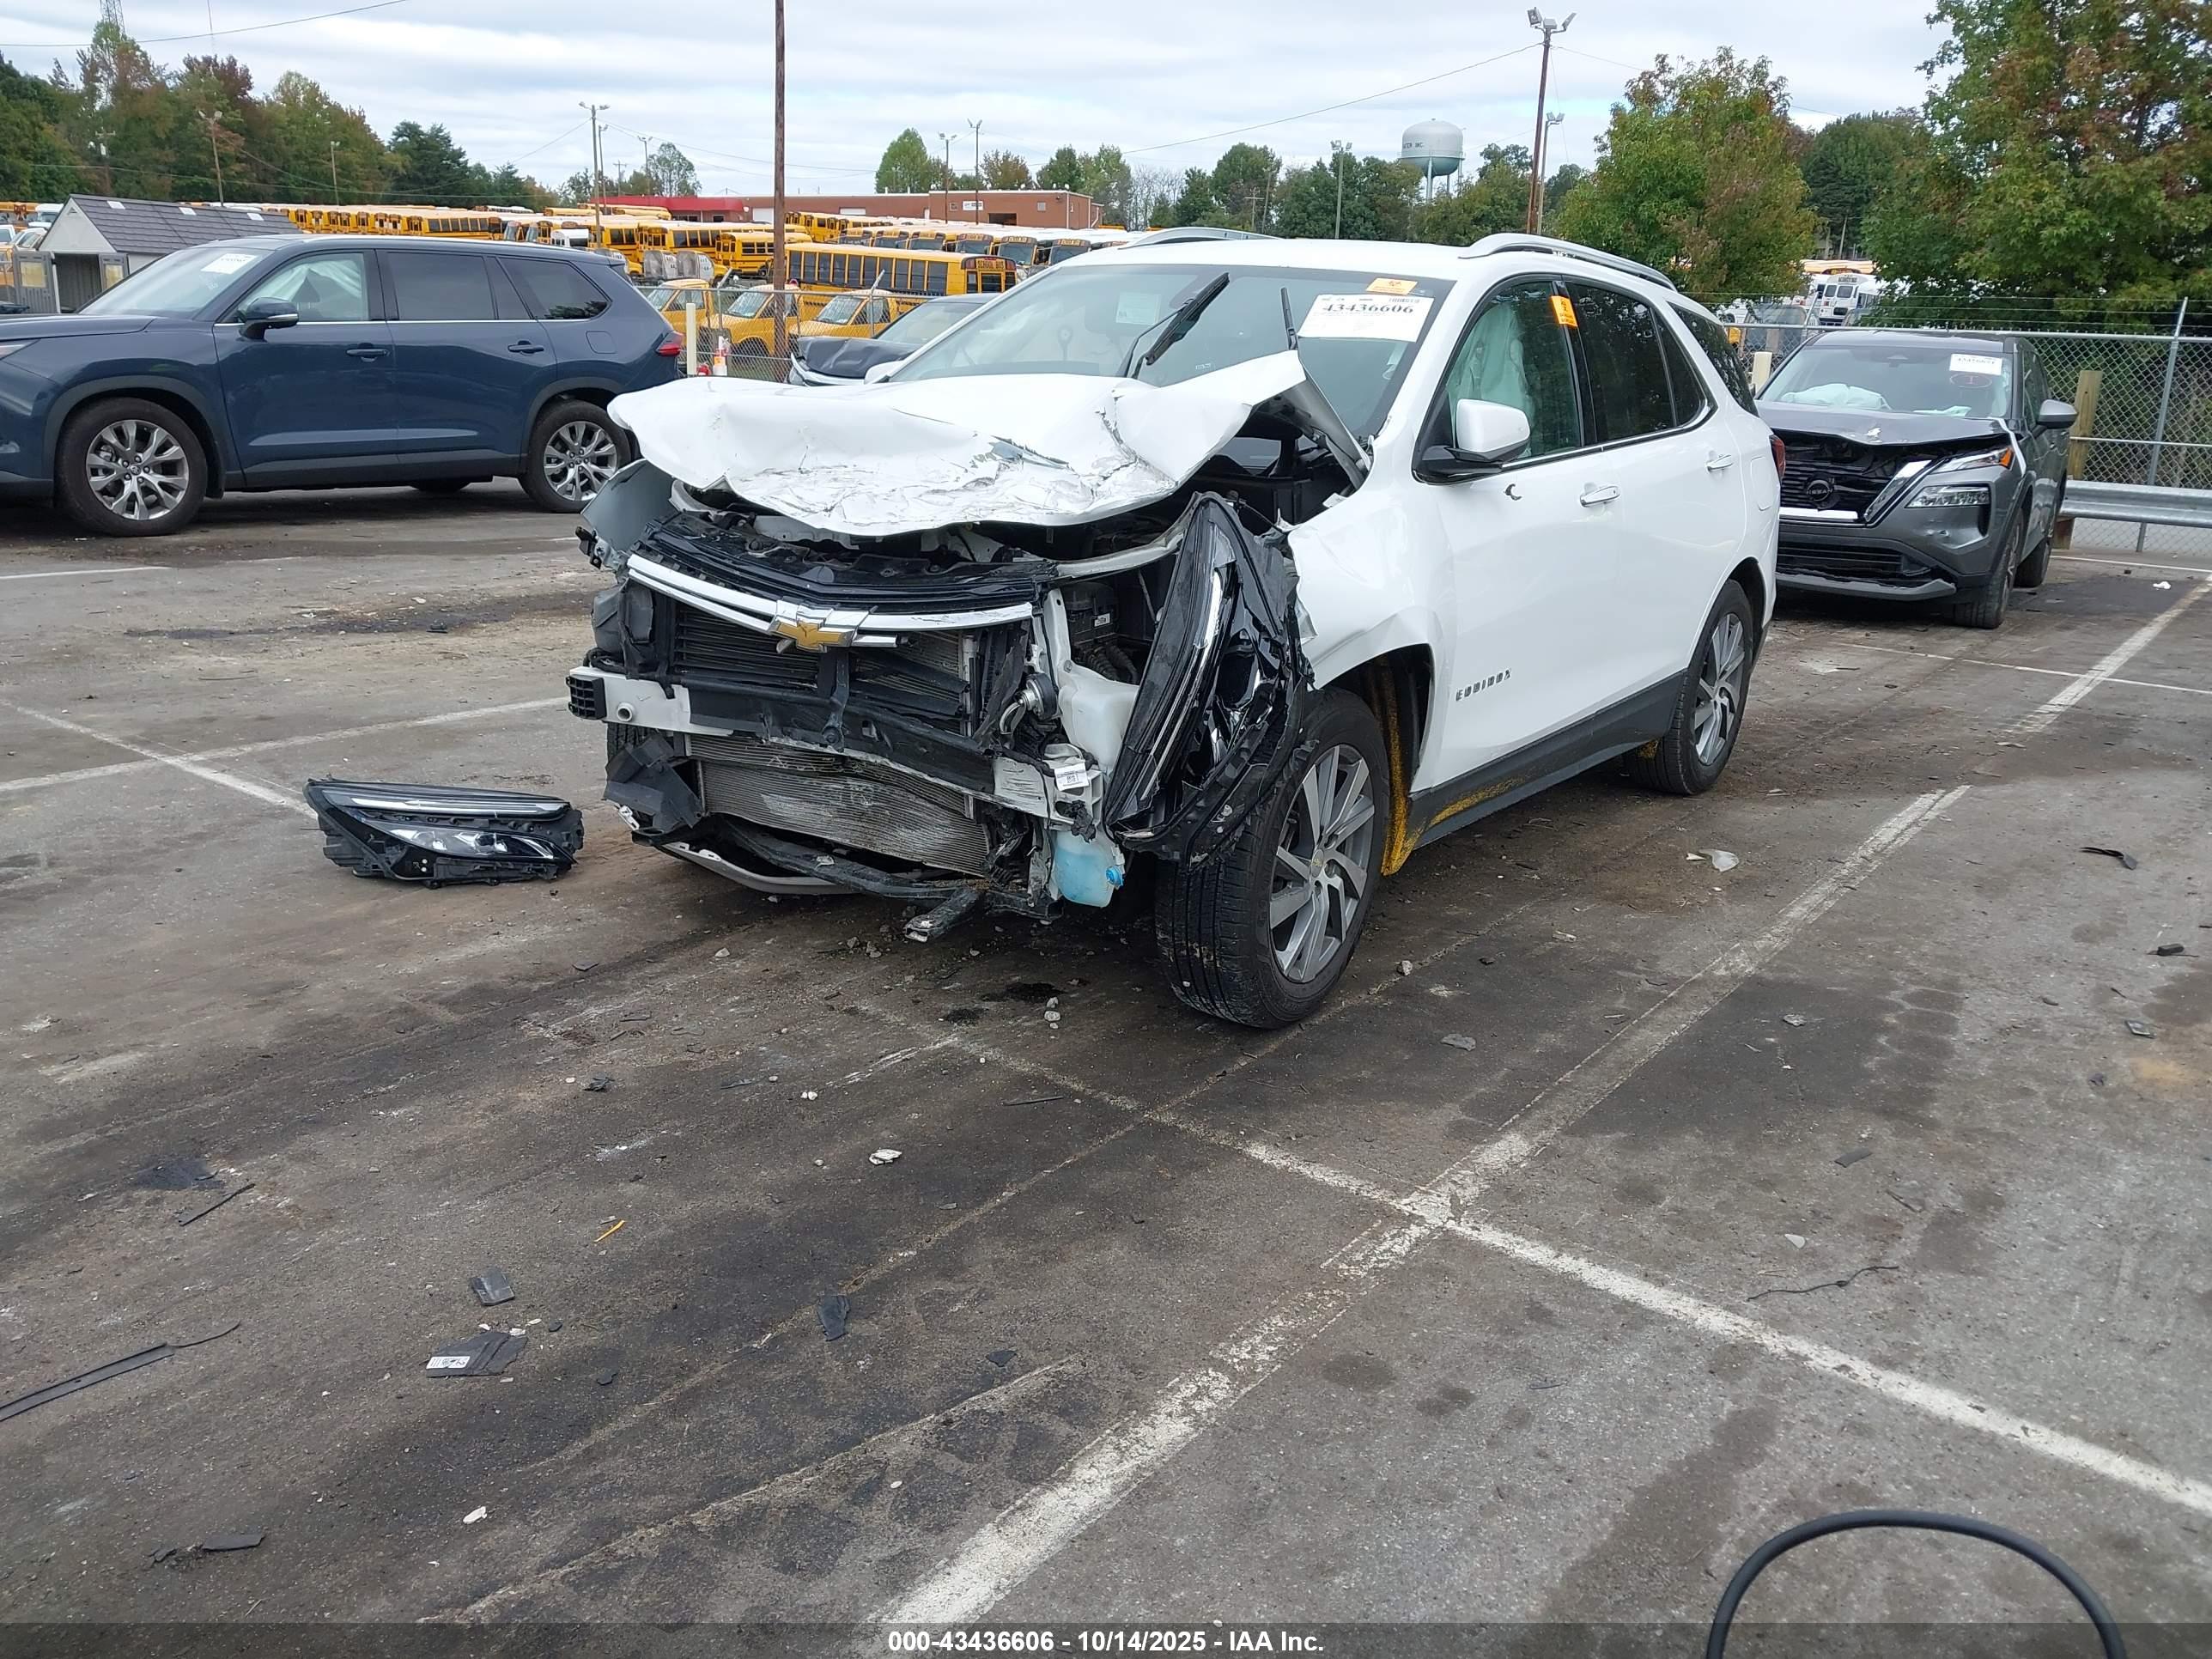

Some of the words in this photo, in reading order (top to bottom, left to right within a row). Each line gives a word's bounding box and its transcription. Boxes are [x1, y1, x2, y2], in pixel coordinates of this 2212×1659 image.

[977, 260, 994, 269] SCHOOL
[995, 260, 1005, 270] BUS
[1322, 303, 1414, 314] 43436606
[1455, 667, 1512, 702] EQUINOX
